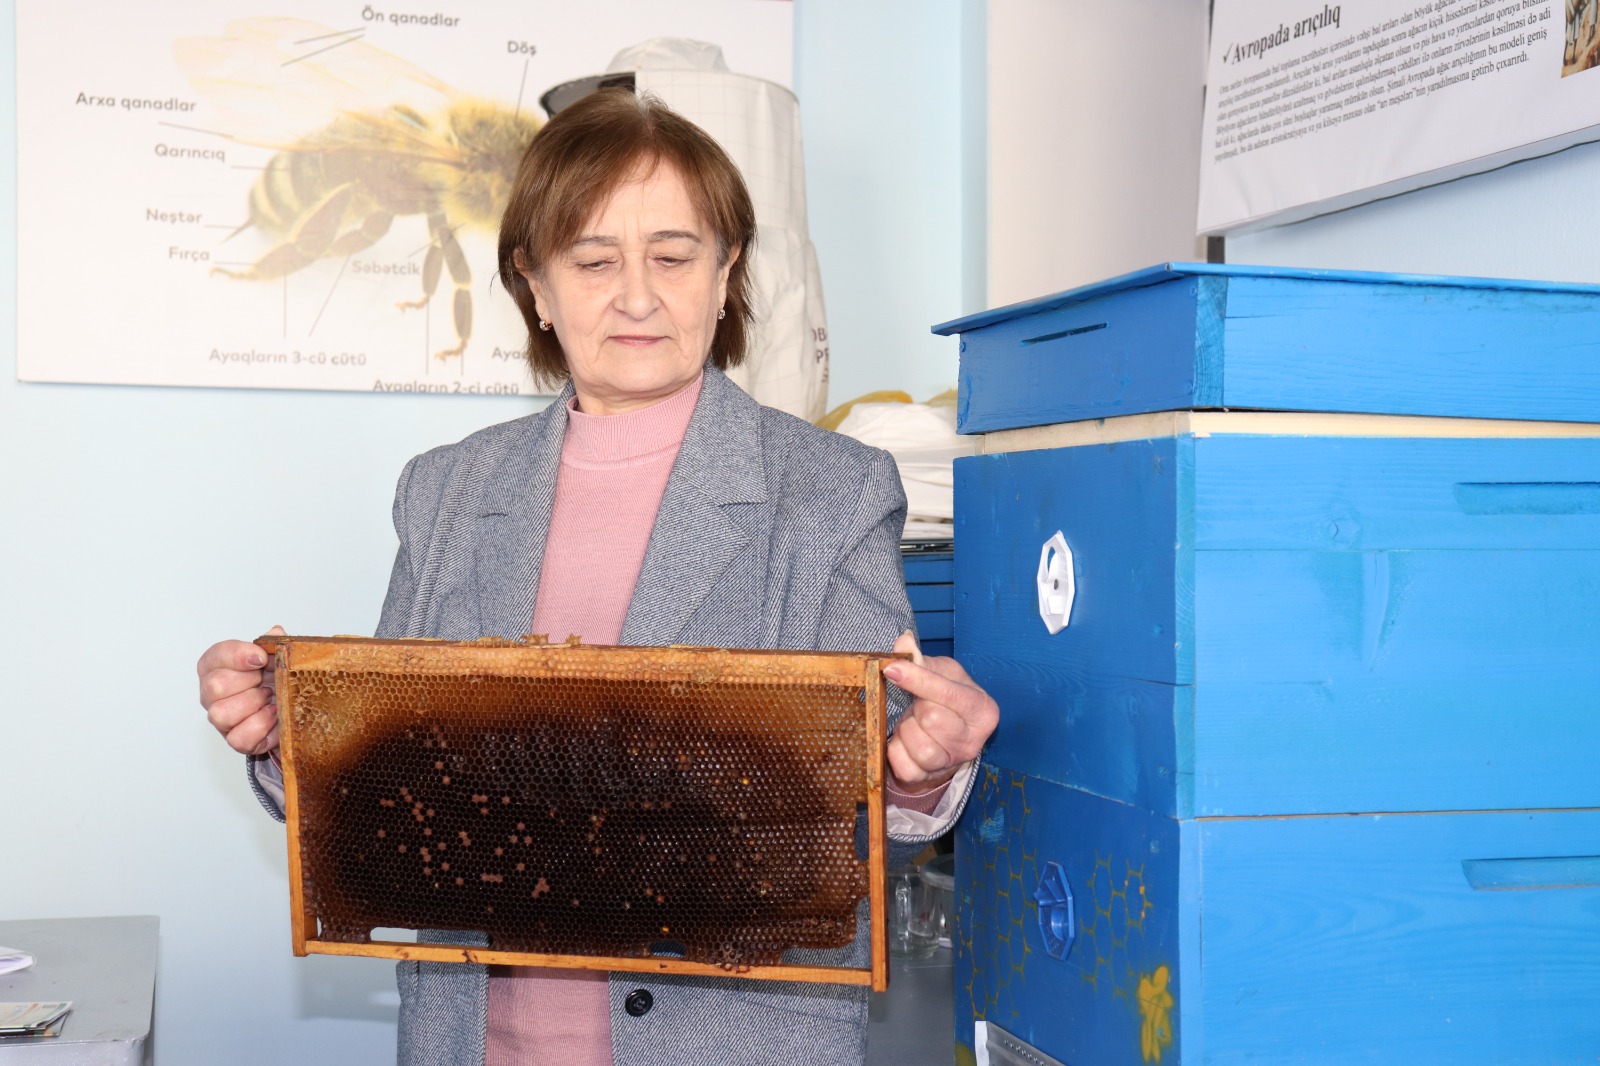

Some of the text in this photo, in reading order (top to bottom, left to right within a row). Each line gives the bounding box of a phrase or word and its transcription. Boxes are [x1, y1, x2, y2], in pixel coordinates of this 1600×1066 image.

[361, 5, 460, 27] Ön qanadlar
[1446, 4, 1477, 22] hissələrini
[1456, 13, 1494, 37] yırtıcılardan
[1496, 3, 1520, 21] qoruya
[1231, 4, 1341, 65] Avropada arıçılıq
[1454, 31, 1490, 51] zirvələrinin
[1492, 19, 1525, 37] kəsilməsi
[1528, 13, 1537, 24] də
[1539, 7, 1550, 21] adi
[507, 40, 537, 57] Döş
[1451, 49, 1486, 68] arıçılığının
[1488, 45, 1497, 55] bu
[1499, 33, 1525, 51] modeli
[1527, 27, 1547, 45] geniş
[1427, 72, 1469, 95] yaradılmasına
[1471, 61, 1494, 80] gətirib
[1496, 51, 1529, 72] çıxarırdı.
[76, 92, 197, 112] Arxa qanadlar
[155, 143, 226, 162] Qarıncıq
[168, 246, 210, 263] Fırça
[209, 348, 367, 366] Ayaqların 3-cü cütü
